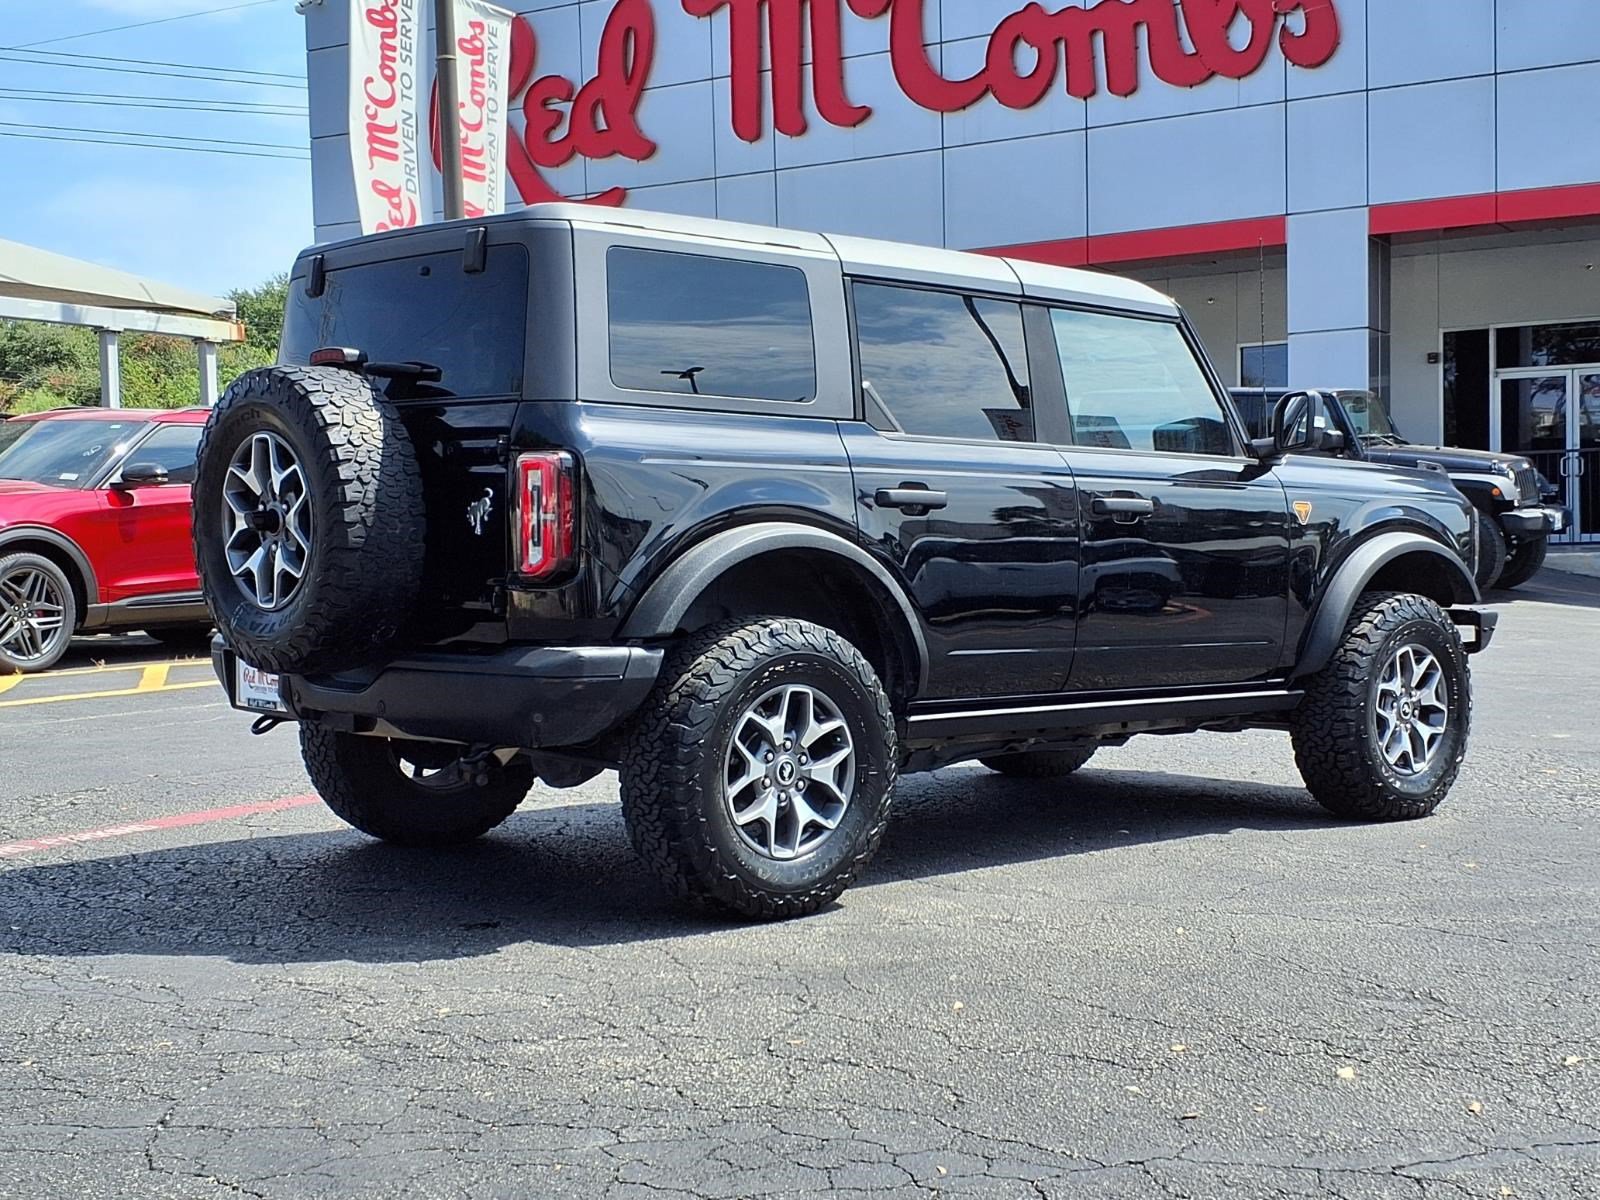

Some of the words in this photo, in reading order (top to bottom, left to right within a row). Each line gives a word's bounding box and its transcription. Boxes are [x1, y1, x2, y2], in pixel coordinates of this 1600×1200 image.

[400, 72, 413, 102] TO
[486, 23, 499, 92] SERVE
[486, 97, 499, 126] TO
[402, 109, 417, 195] DRIVEN
[487, 132, 497, 214] DRIVEN
